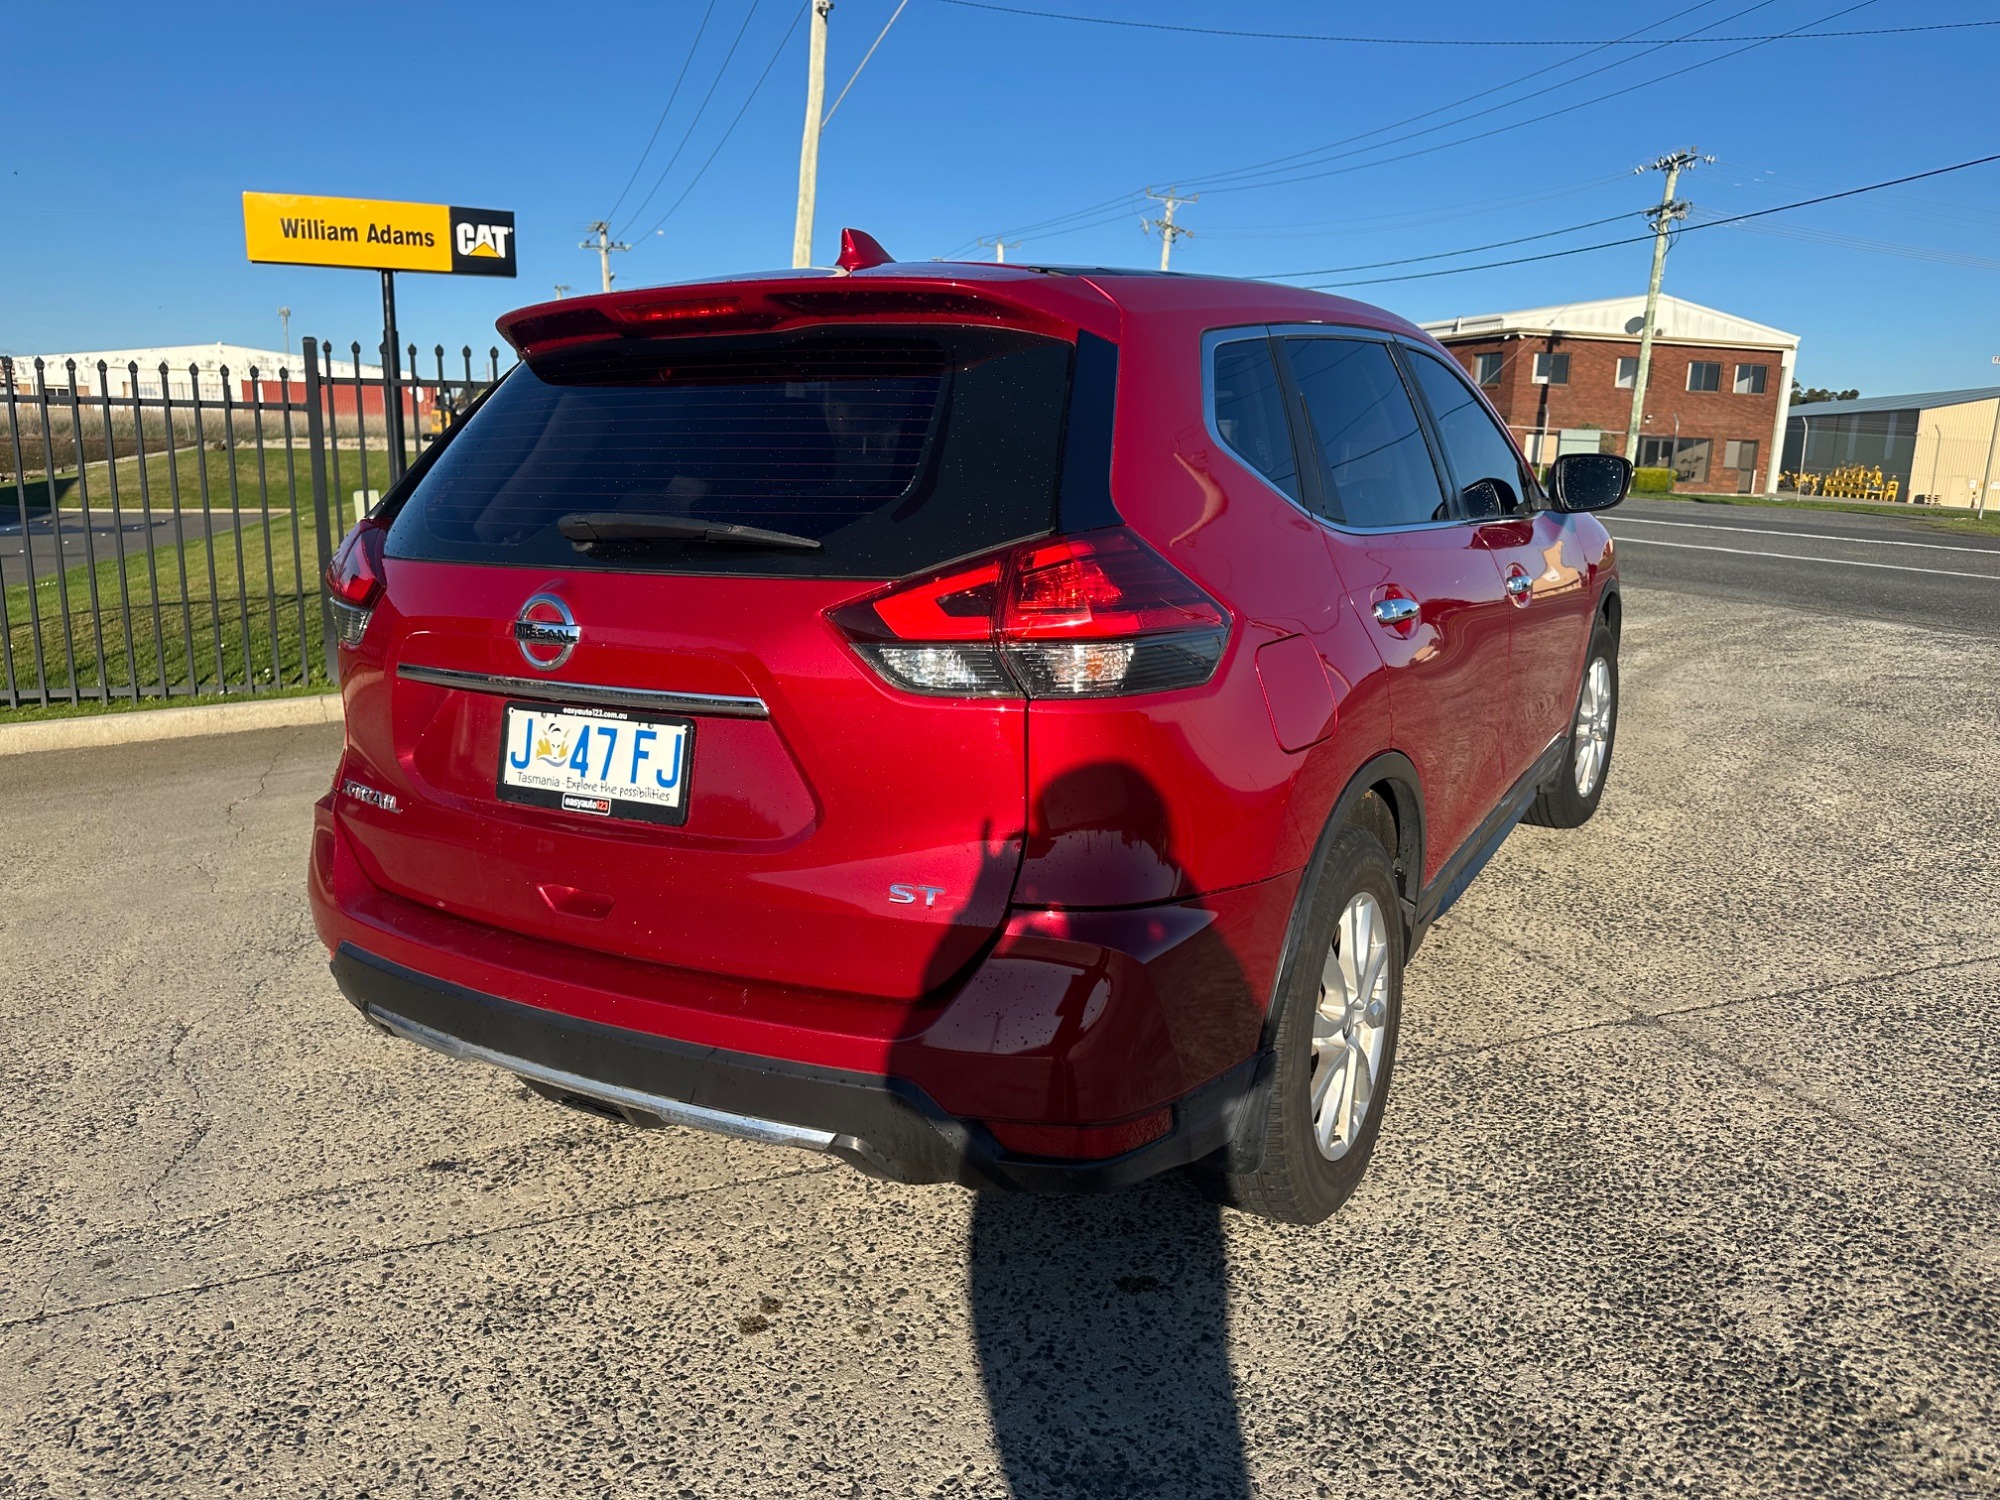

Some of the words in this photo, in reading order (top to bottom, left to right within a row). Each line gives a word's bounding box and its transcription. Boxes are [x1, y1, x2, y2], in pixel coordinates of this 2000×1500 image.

[280, 217, 358, 242] William
[366, 222, 435, 248] Adams
[456, 222, 509, 258] CAT
[563, 707, 628, 721] easyauto123.com.au
[510, 718, 533, 769] J
[569, 725, 618, 781] 47
[630, 729, 682, 788] FJ
[516, 771, 560, 787] Tasmania
[566, 777, 598, 792] Explore
[600, 779, 617, 795] the
[619, 784, 671, 802] possibilities
[564, 796, 609, 811] easyauto123
[888, 883, 946, 907] ST
